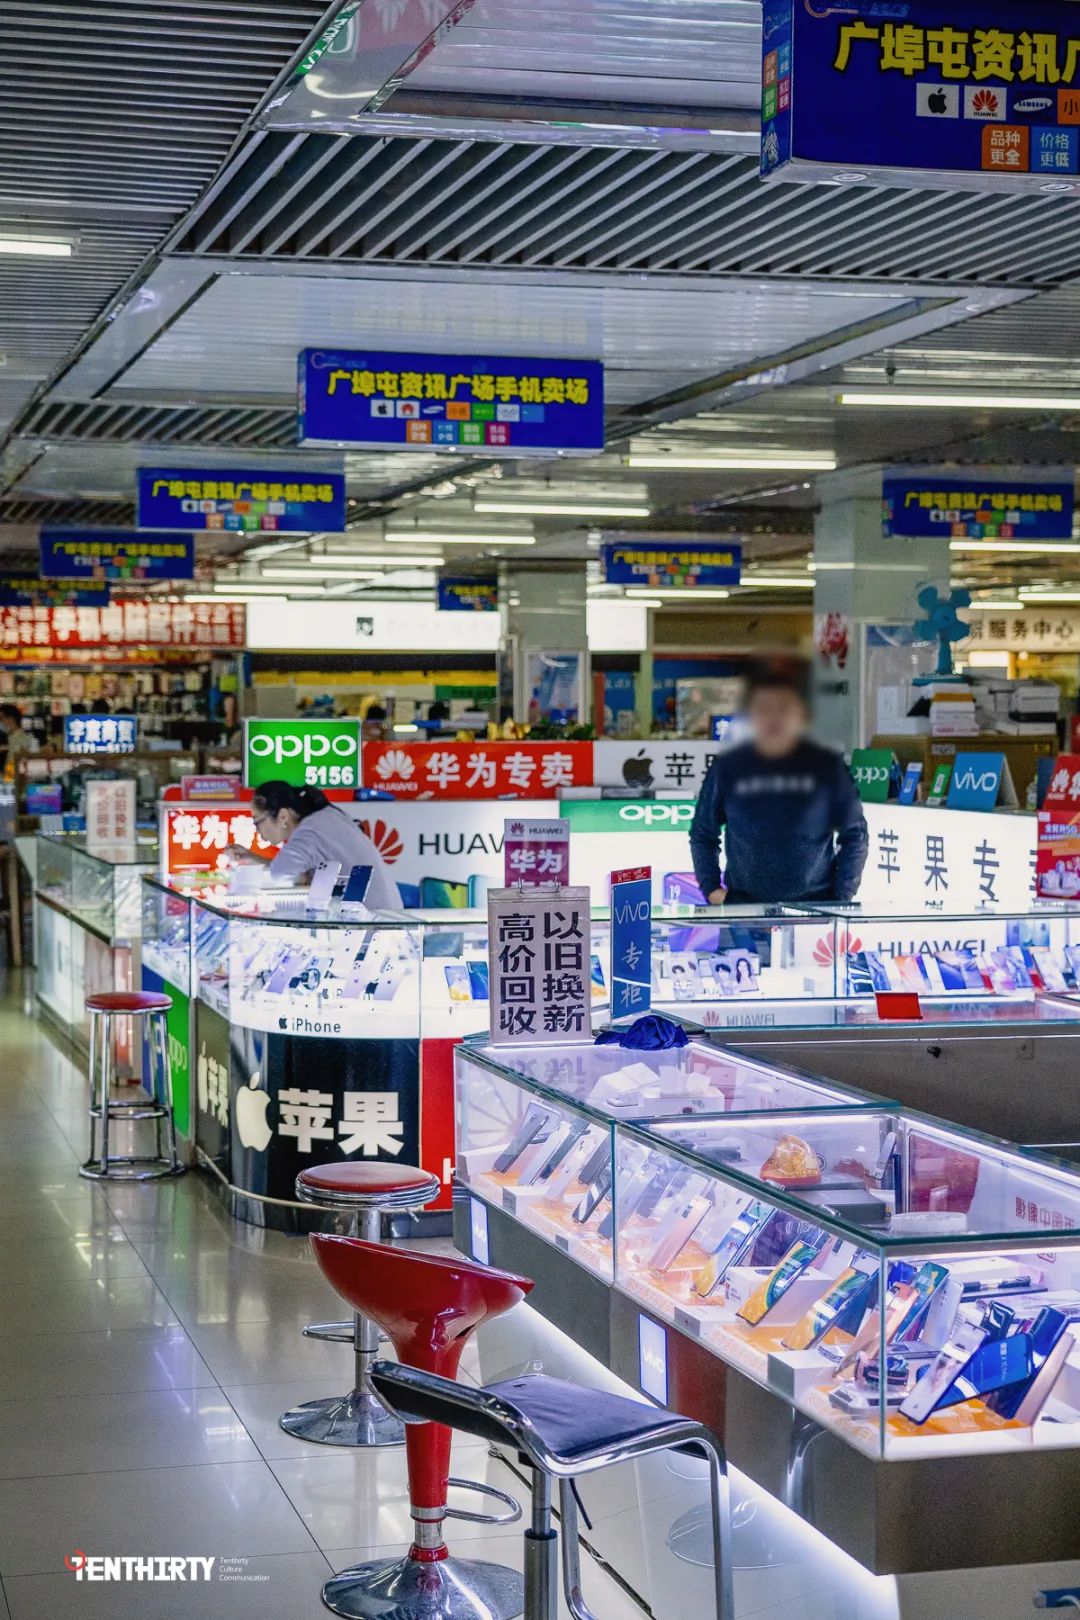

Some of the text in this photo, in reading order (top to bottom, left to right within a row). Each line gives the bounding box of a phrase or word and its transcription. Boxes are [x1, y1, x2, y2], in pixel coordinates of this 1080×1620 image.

[1064, 98, 1080, 116] 小
[991, 130, 1020, 147] 品种
[1040, 133, 1069, 149] 价格
[991, 149, 1020, 166] 更全
[1040, 151, 1069, 168] 更低
[327, 369, 589, 405] 广埠屯资讯广场手机卖场
[249, 734, 357, 764] oppo
[304, 766, 355, 785] 5156
[425, 751, 574, 789] 华为专卖
[954, 766, 998, 791] vivo
[373, 782, 418, 792] HUAWEI
[619, 804, 695, 826] opp
[529, 827, 563, 835] HUAWEI
[510, 849, 562, 874] 华为
[615, 900, 650, 925] vivo
[497, 913, 537, 1036] 高价回收
[543, 911, 585, 1033] 以旧换新
[621, 942, 643, 1008] 专柜
[291, 1018, 341, 1033] iPhone
[277, 1088, 404, 1156] 苹果
